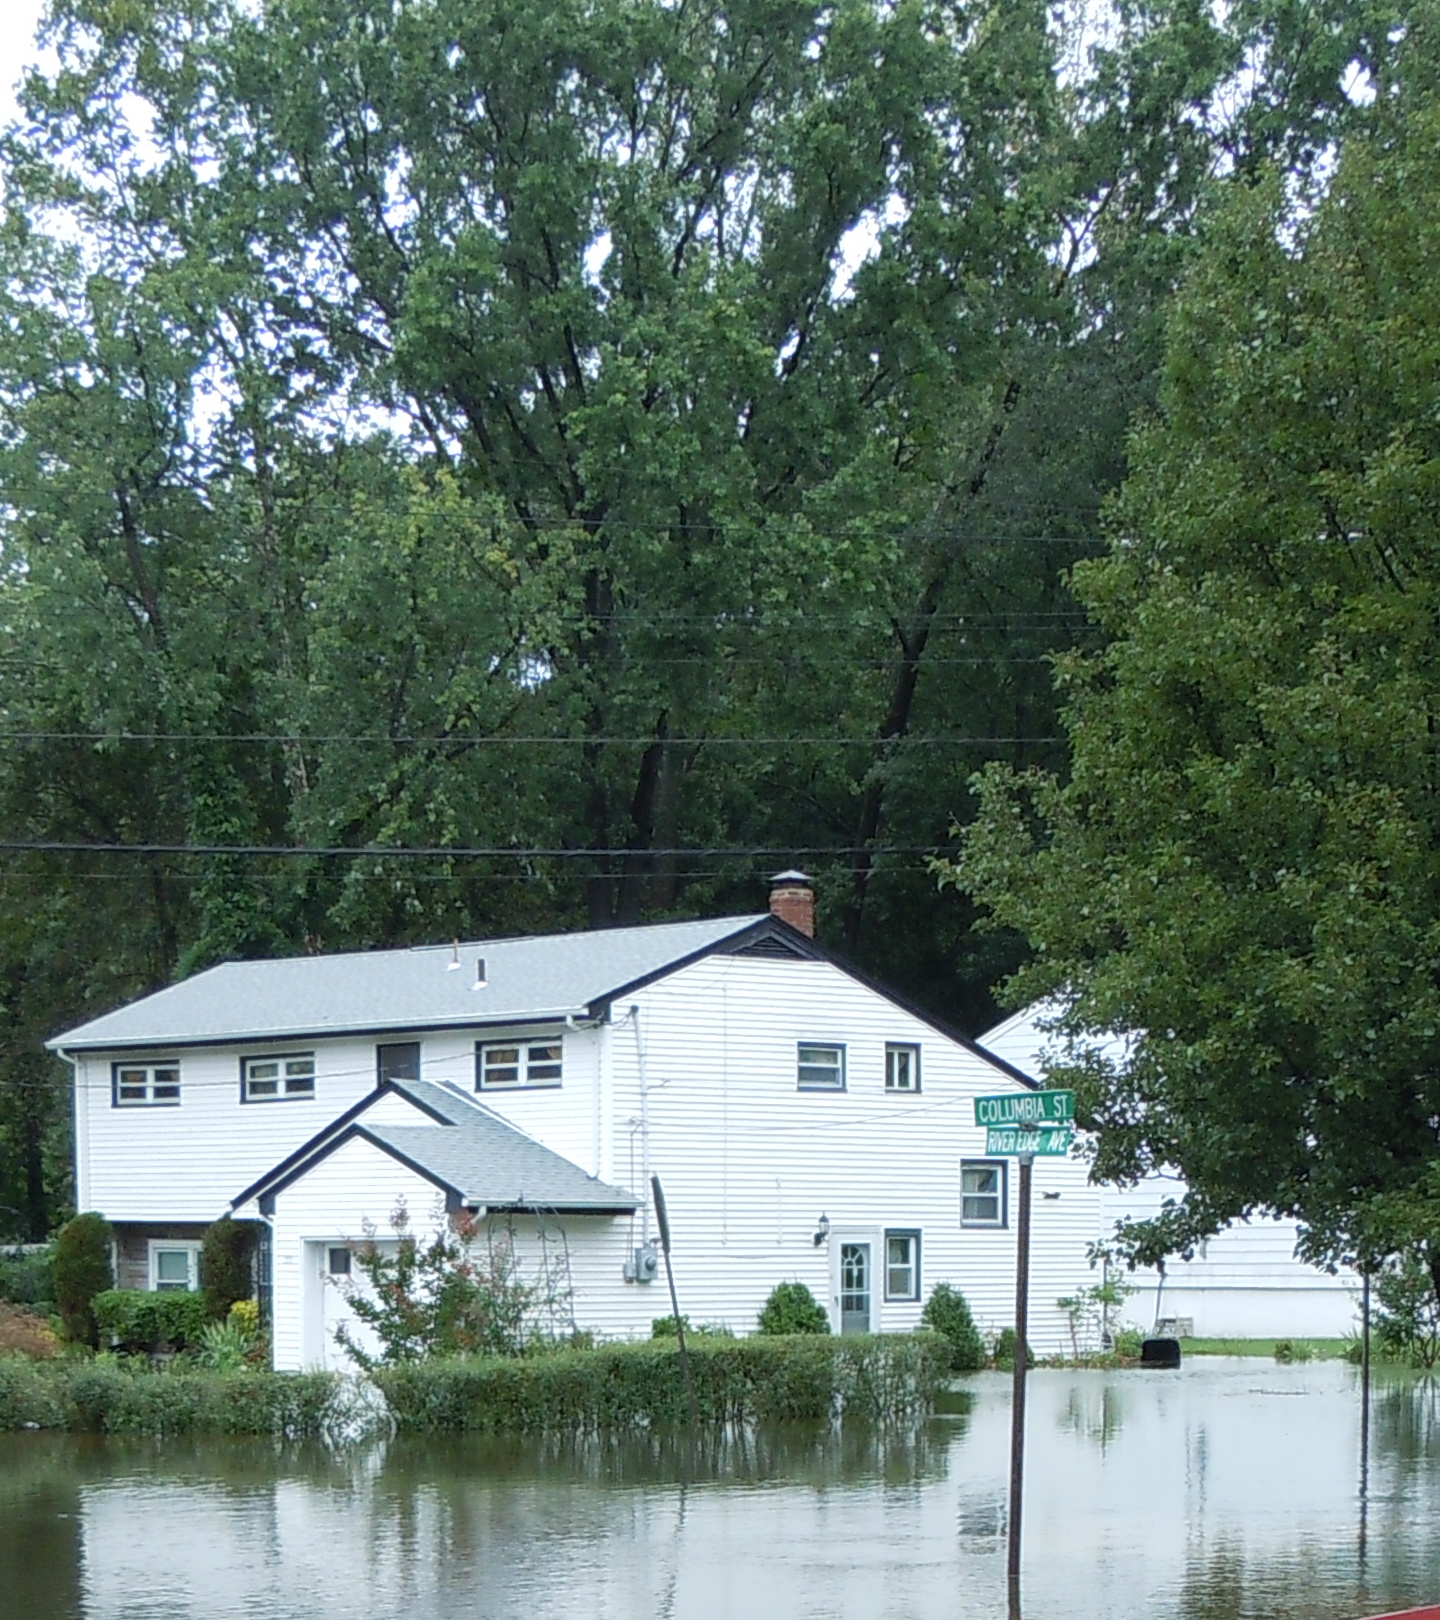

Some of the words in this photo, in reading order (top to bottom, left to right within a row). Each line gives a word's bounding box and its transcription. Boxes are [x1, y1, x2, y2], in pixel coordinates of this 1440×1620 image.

[978, 1096, 1046, 1122] COLUMBIA
[1053, 1095, 1068, 1117] ST
[987, 1131, 1016, 1153] RIVER
[1016, 1130, 1042, 1152] EDGE
[1046, 1130, 1068, 1152] AVE
